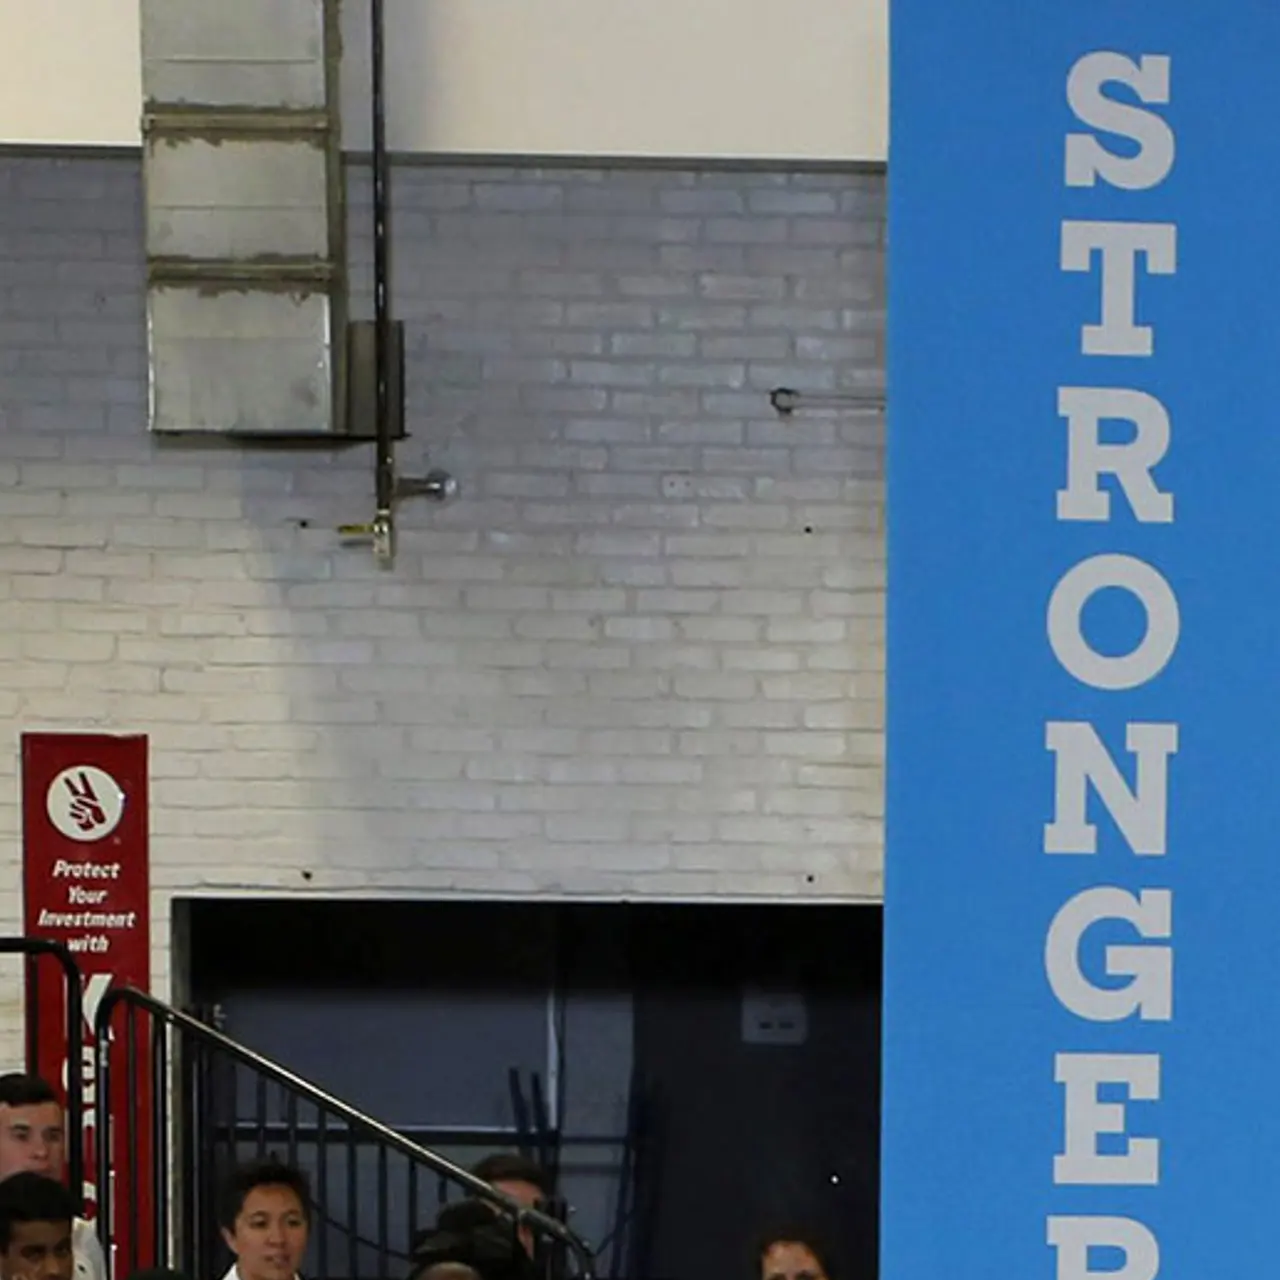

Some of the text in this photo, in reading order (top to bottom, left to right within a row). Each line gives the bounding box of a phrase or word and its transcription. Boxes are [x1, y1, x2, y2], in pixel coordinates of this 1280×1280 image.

[52, 859, 121, 879] Protect
[68, 885, 109, 904] Your
[38, 909, 137, 929] Investment
[67, 934, 110, 953] with
